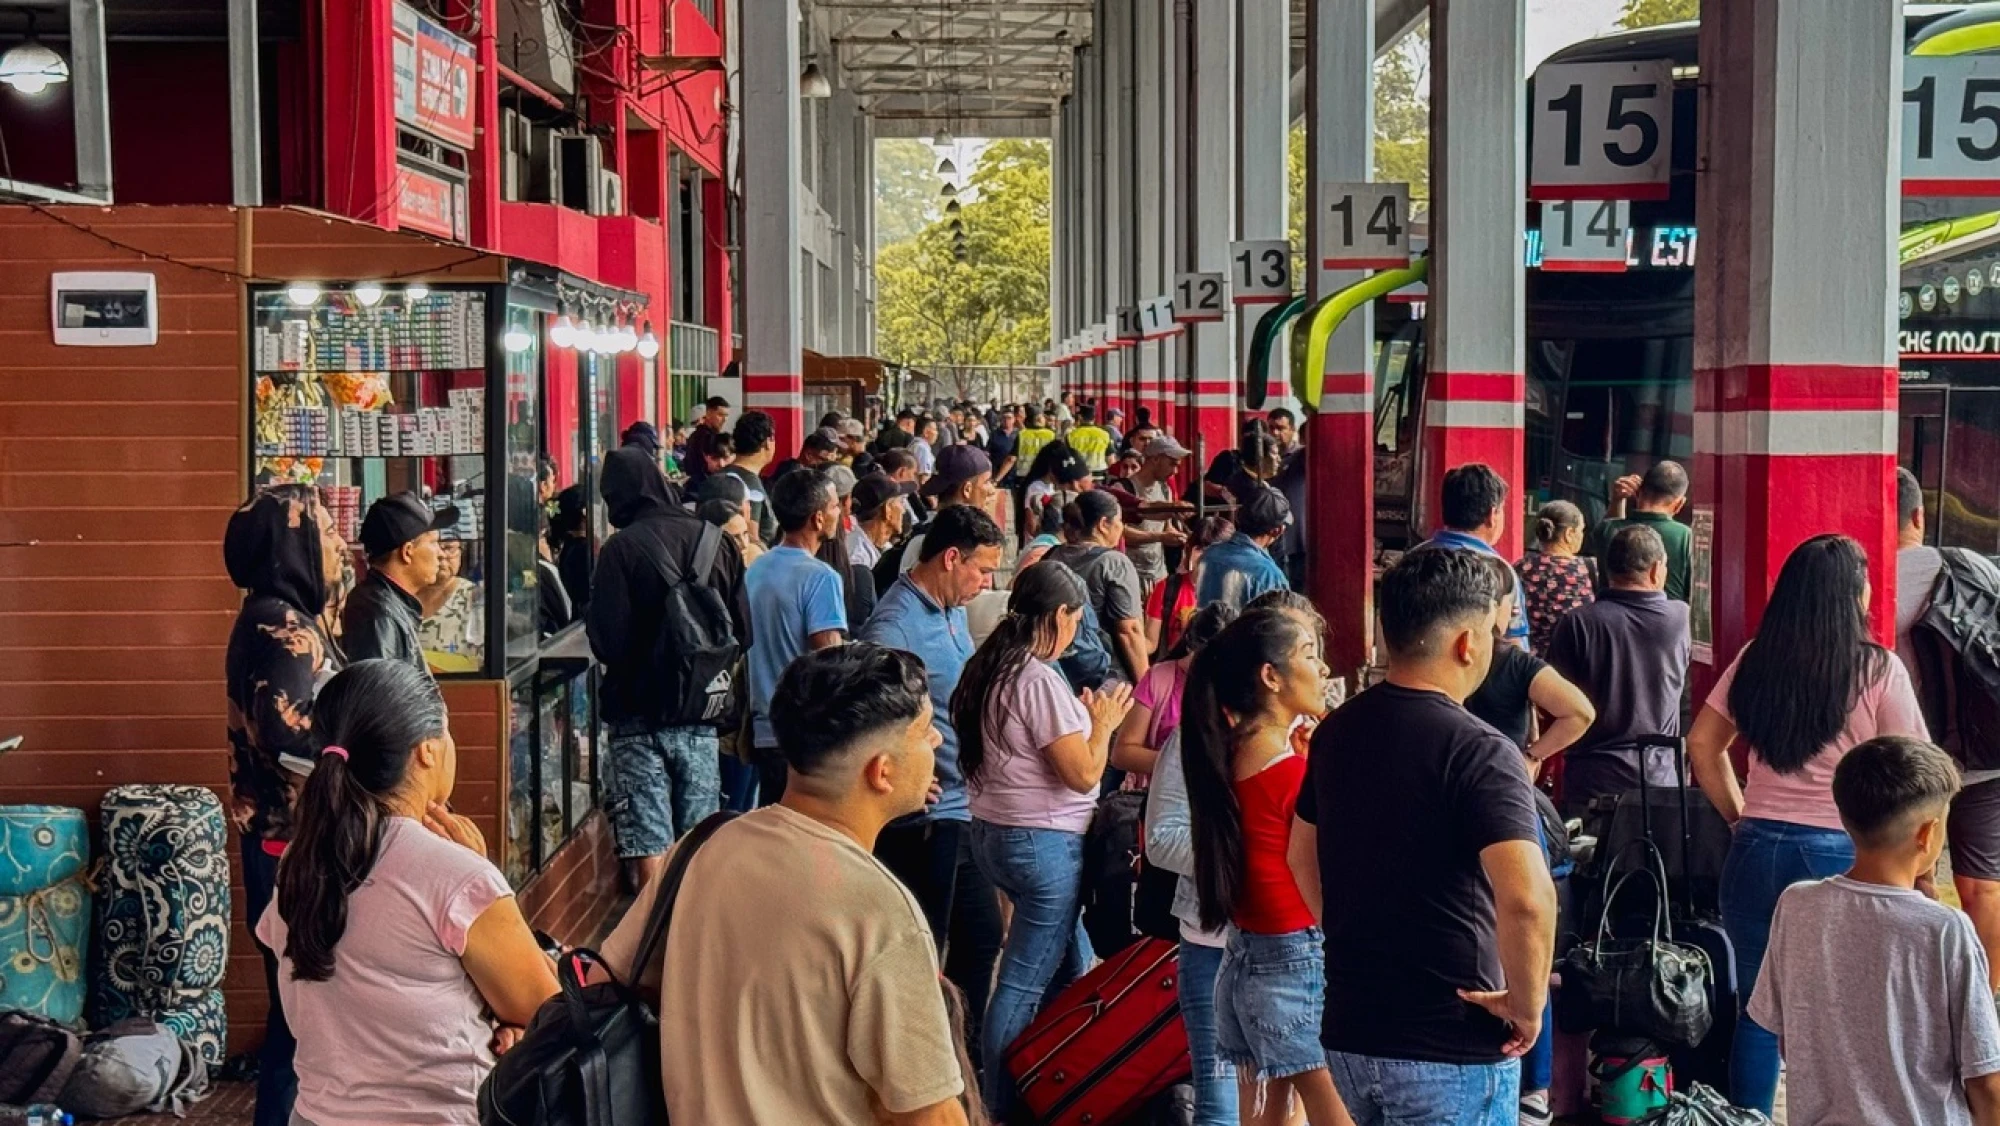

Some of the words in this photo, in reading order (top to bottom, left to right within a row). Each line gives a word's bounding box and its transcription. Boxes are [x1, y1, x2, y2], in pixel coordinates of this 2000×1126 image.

[1548, 84, 1659, 167] 15
[1902, 76, 2000, 161] 15
[1331, 195, 1402, 246] 14
[1552, 201, 1621, 248] 14
[1235, 249, 1286, 288] 13
[1146, 300, 1175, 328] 11
[1178, 279, 1219, 309] 12
